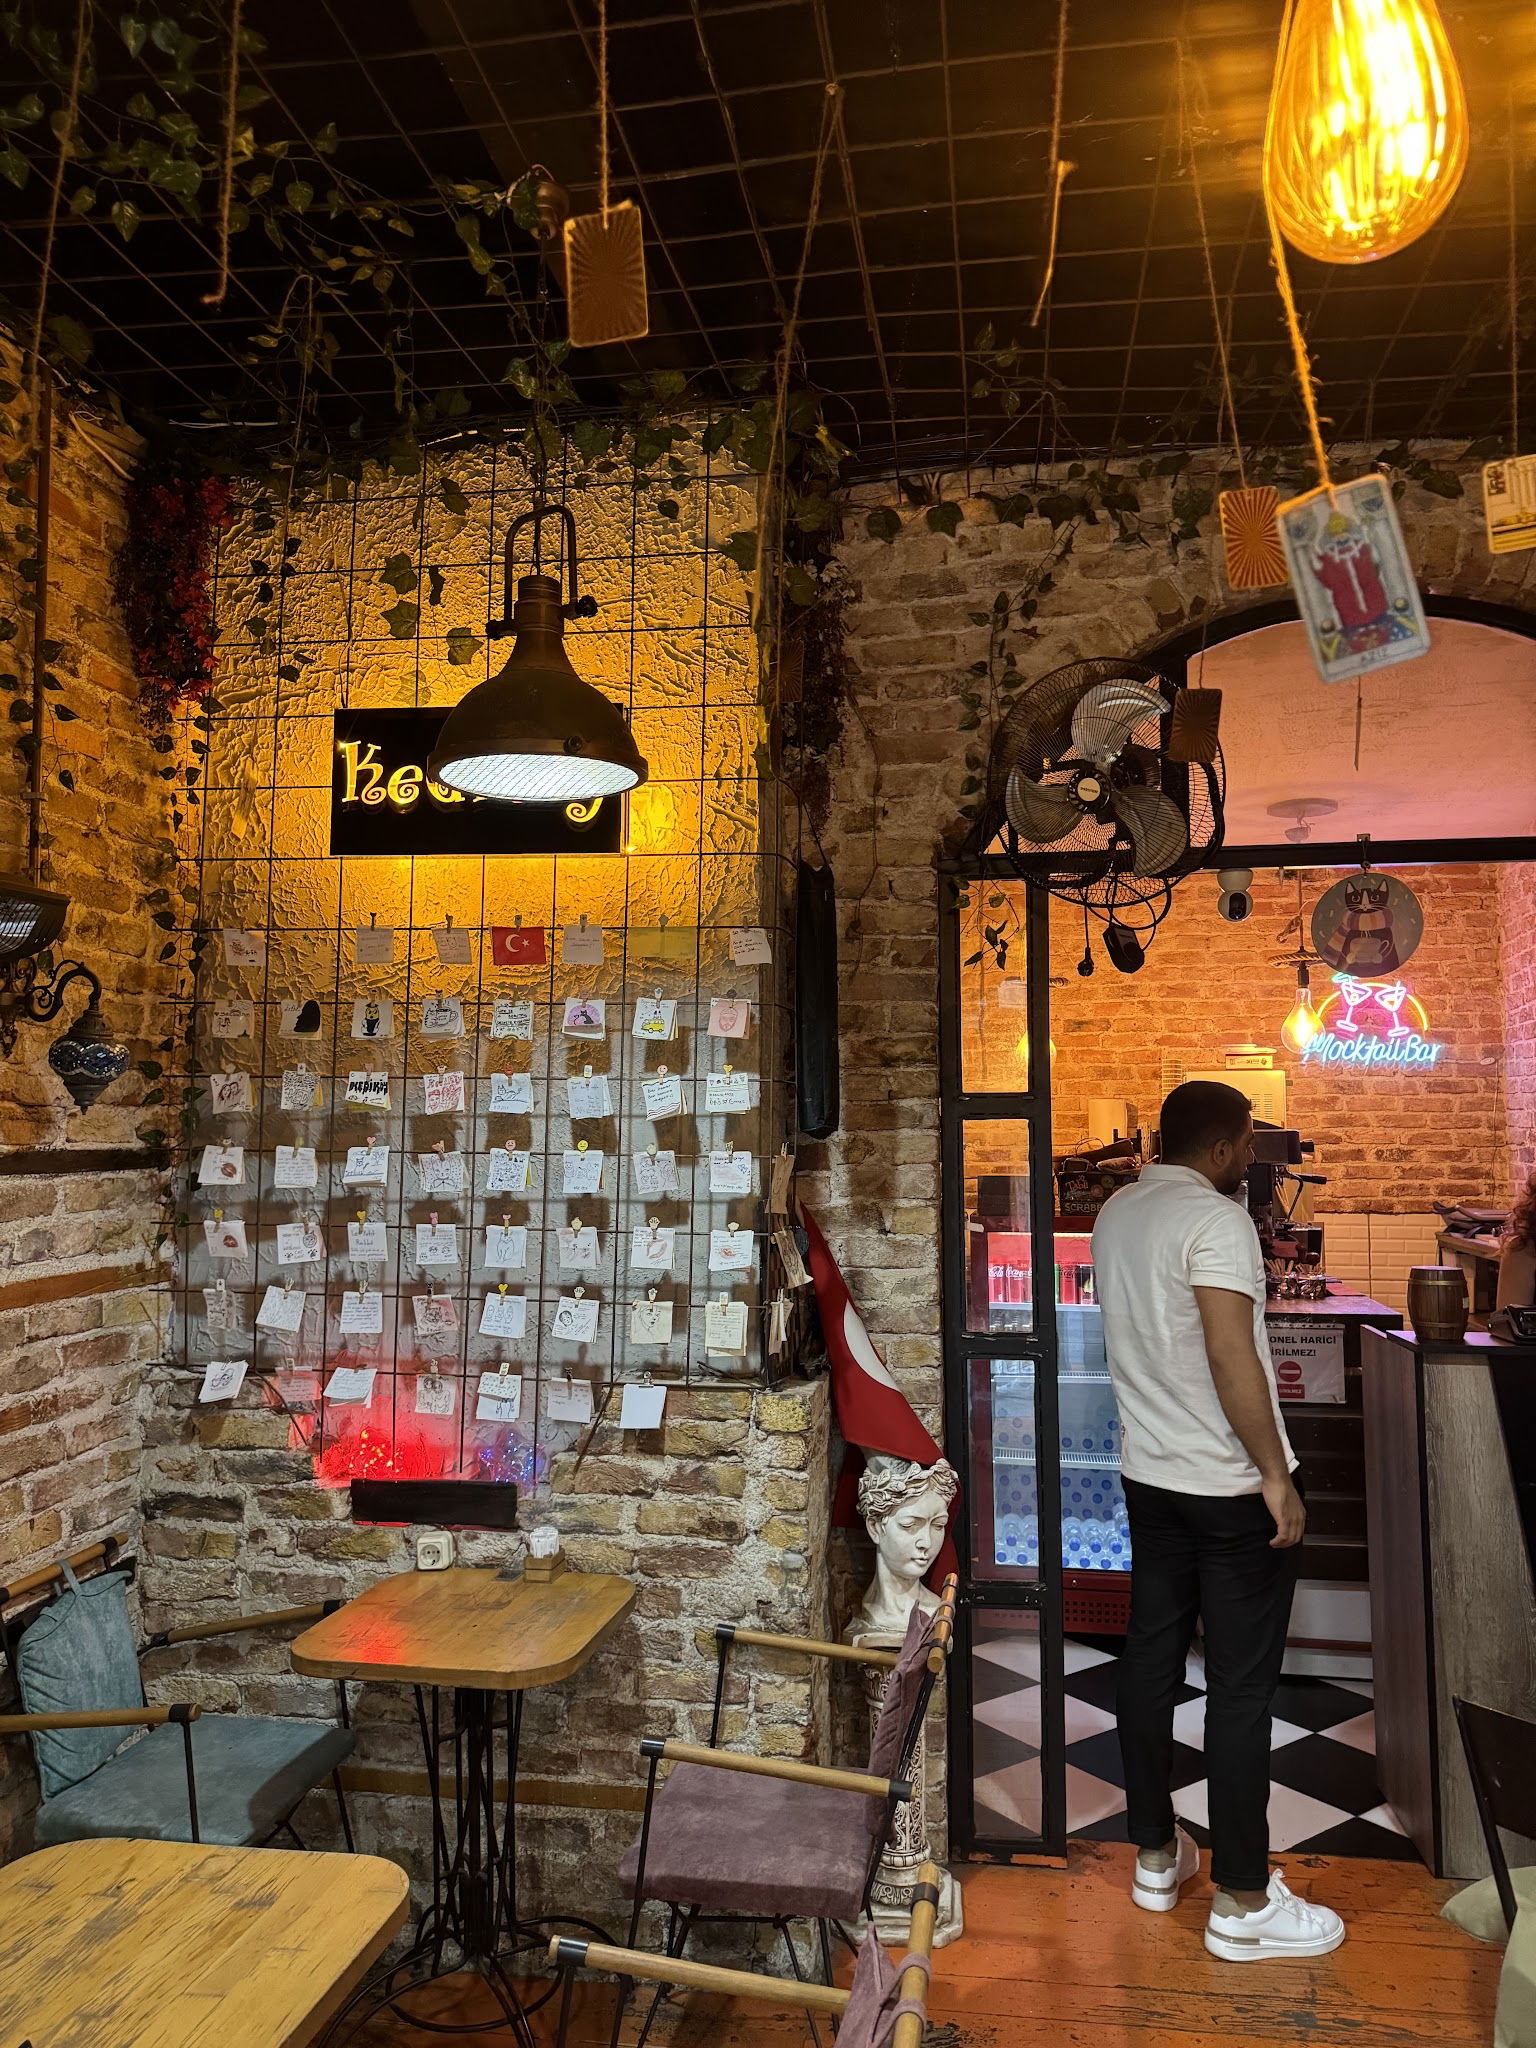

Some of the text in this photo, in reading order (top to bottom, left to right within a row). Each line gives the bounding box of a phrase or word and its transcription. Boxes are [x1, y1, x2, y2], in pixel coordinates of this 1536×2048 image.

[1301, 1033, 1442, 1065] Mocktail Bar
[1301, 1336, 1336, 1344] HARİCİ
[1271, 1347, 1316, 1356] İRİLMEZ!
